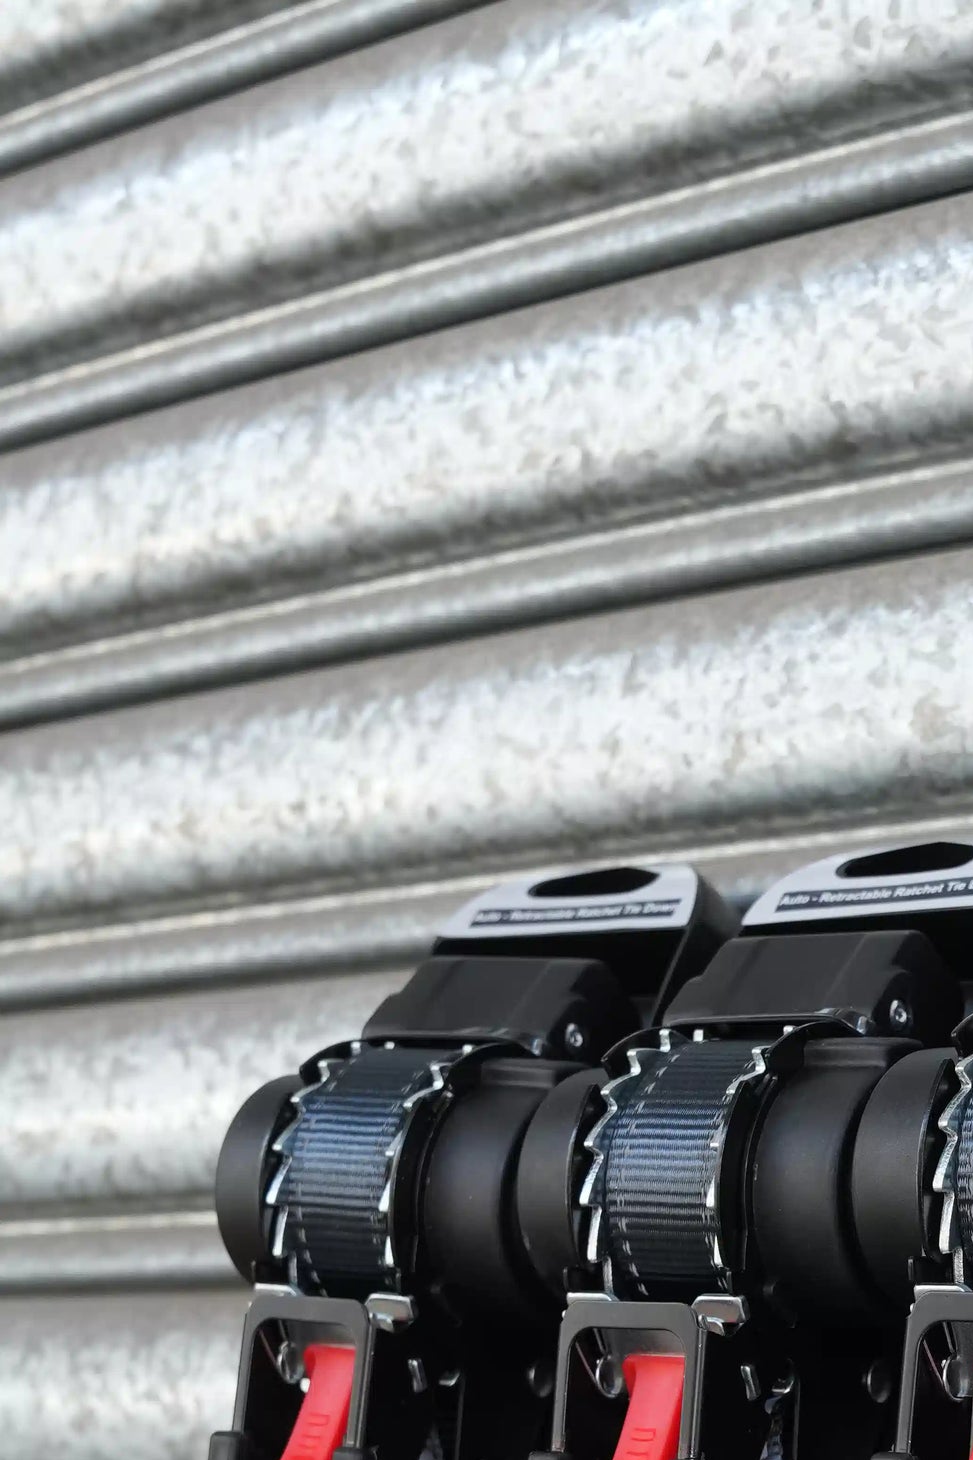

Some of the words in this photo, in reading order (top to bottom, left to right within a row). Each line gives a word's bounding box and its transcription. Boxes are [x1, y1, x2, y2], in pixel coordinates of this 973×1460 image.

[779, 894, 809, 906] Auto
[818, 890, 890, 903] Retractable
[893, 883, 944, 897] Ratchet
[946, 880, 966, 891] Tie
[578, 905, 622, 918] Ratchet
[624, 904, 643, 915] Tie
[643, 902, 675, 913] Down
